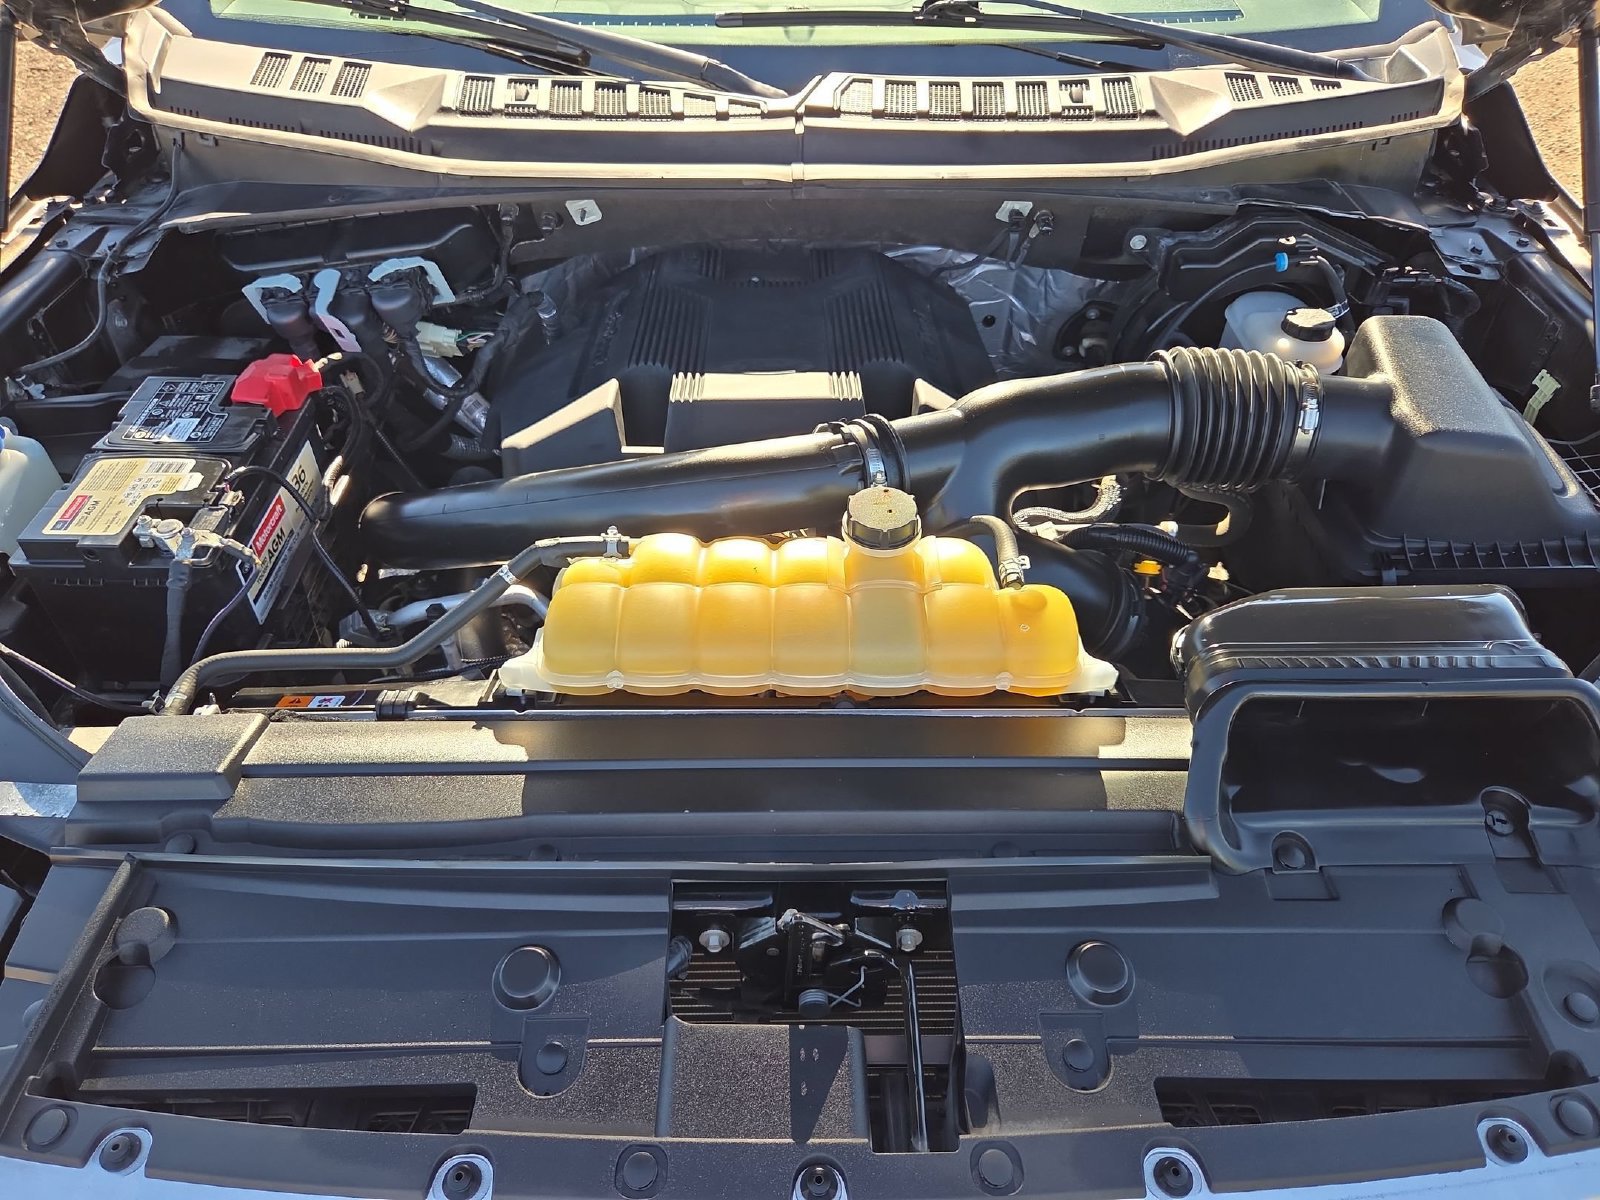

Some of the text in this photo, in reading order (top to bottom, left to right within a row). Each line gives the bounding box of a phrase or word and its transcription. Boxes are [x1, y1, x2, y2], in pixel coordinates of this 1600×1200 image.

[292, 465, 305, 490] 36
[85, 500, 100, 516] AGM
[256, 503, 283, 550] Motorcraft
[268, 526, 285, 562] AGM
